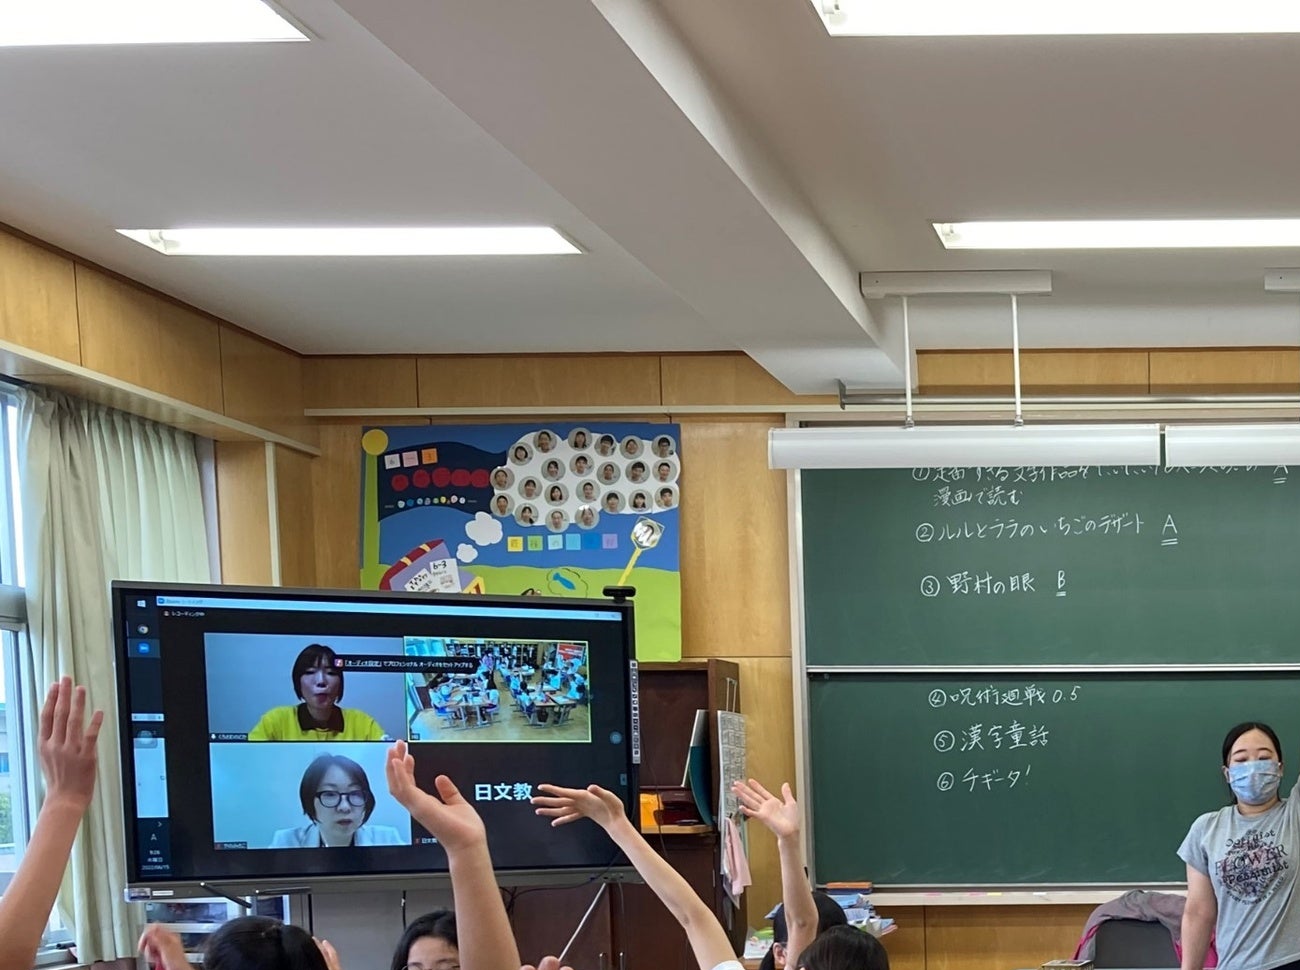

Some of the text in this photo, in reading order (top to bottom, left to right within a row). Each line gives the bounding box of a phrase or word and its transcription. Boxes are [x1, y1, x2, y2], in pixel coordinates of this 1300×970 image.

[1162, 514, 1178, 535] A
[475, 783, 533, 801] 日文教
[1215, 844, 1288, 875] FLOWER
